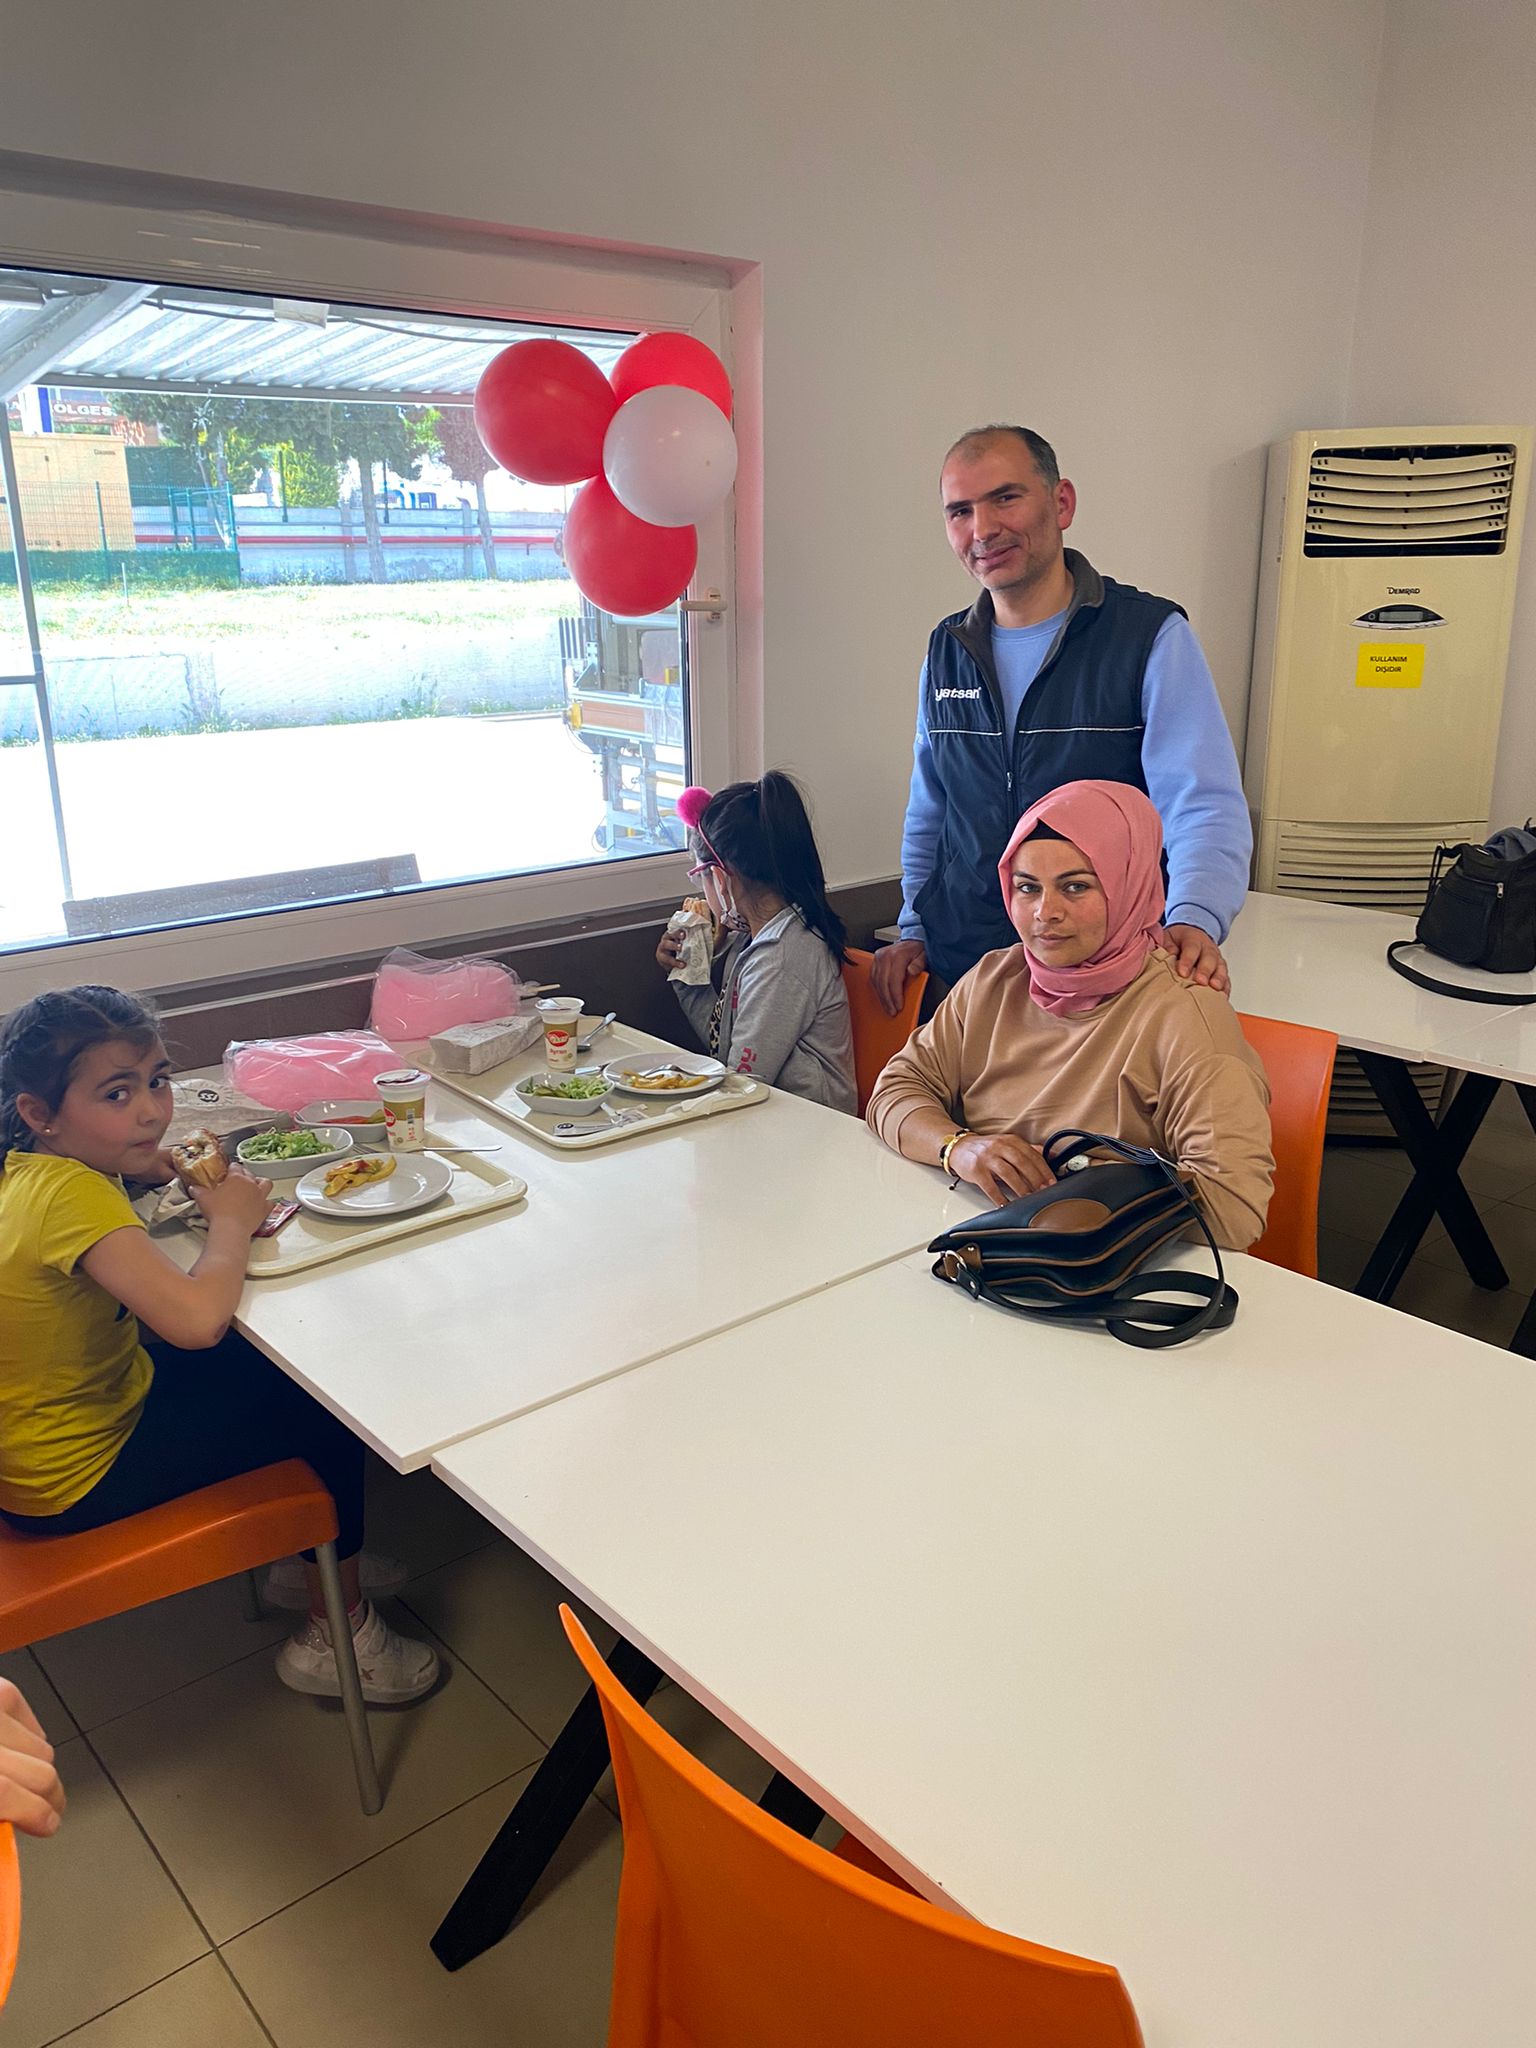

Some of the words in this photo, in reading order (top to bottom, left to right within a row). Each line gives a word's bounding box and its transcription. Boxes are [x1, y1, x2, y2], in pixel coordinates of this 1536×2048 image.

[53, 401, 118, 416] ÖLGES
[1370, 655, 1408, 663] KULLANIM
[1375, 666, 1402, 674] DIŞIDIR
[935, 687, 981, 702] yatsan
